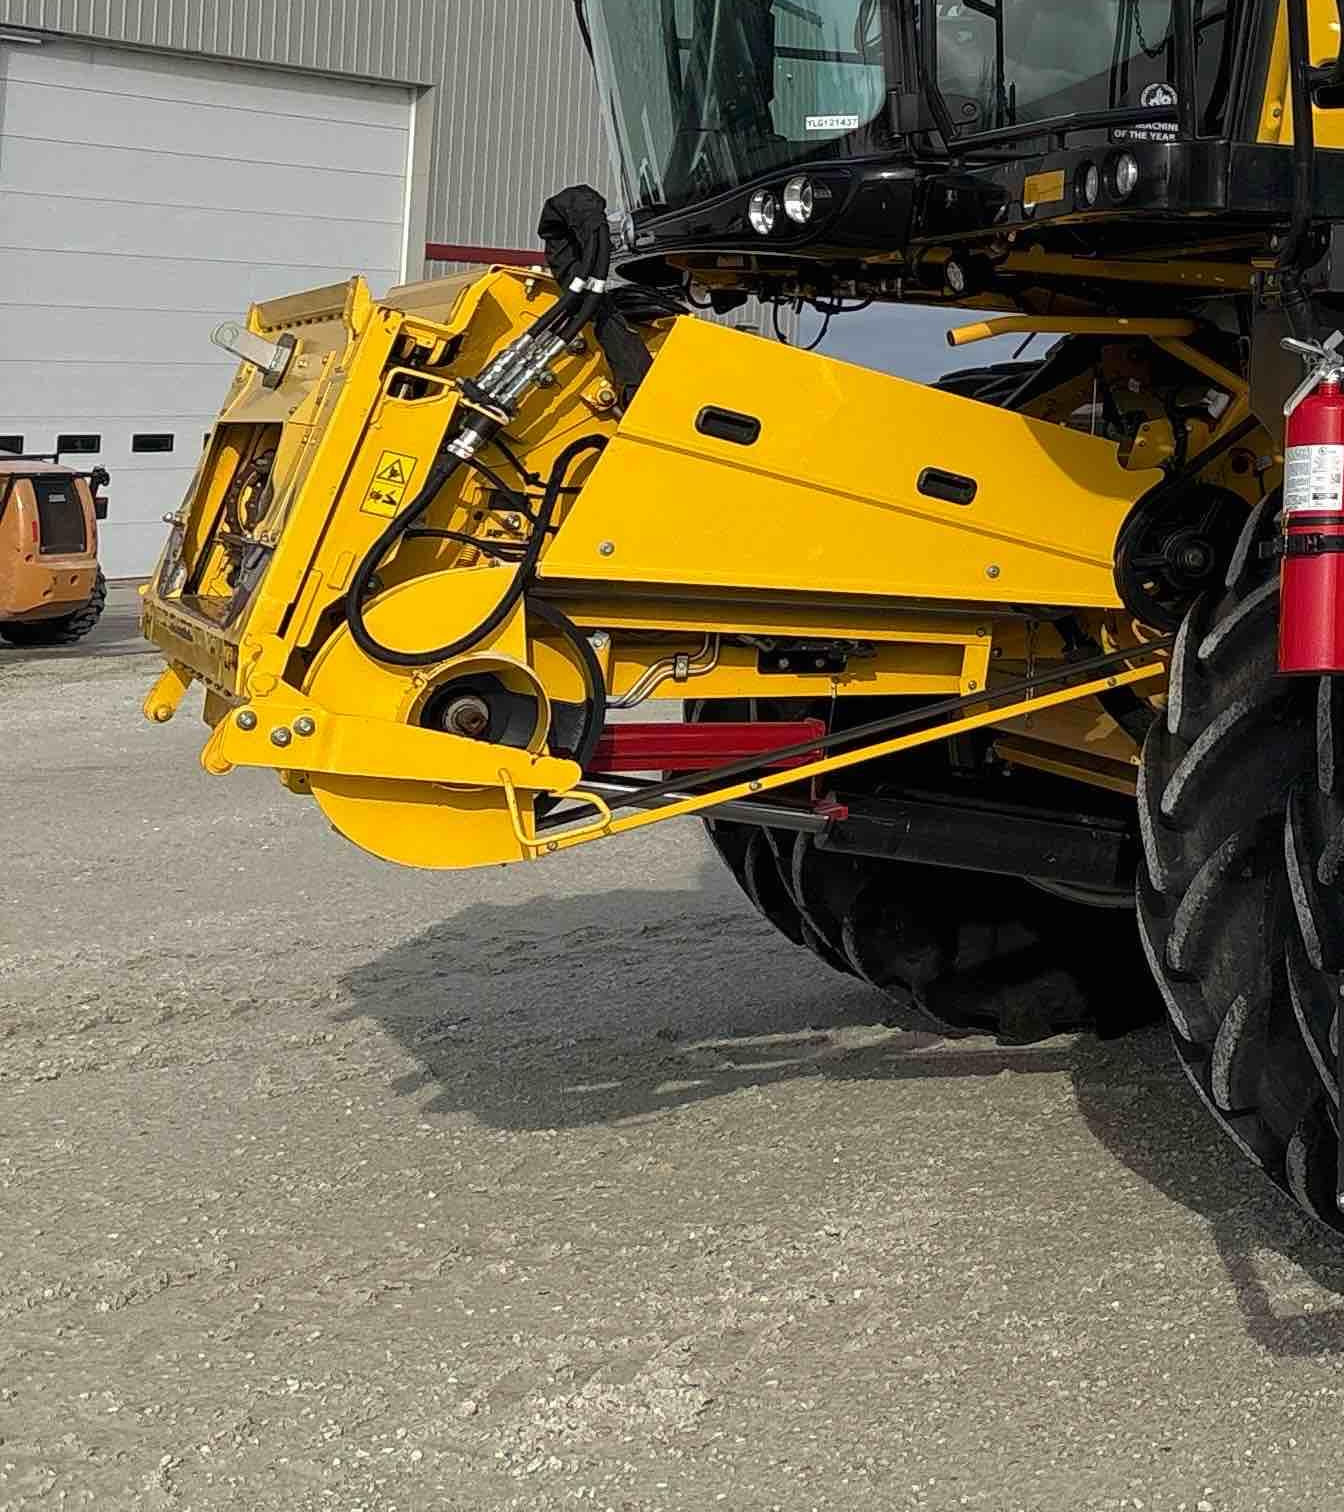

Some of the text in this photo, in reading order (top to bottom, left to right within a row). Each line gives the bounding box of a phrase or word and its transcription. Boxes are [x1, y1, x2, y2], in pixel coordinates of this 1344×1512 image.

[1114, 129, 1176, 142] OF THE YEAR
